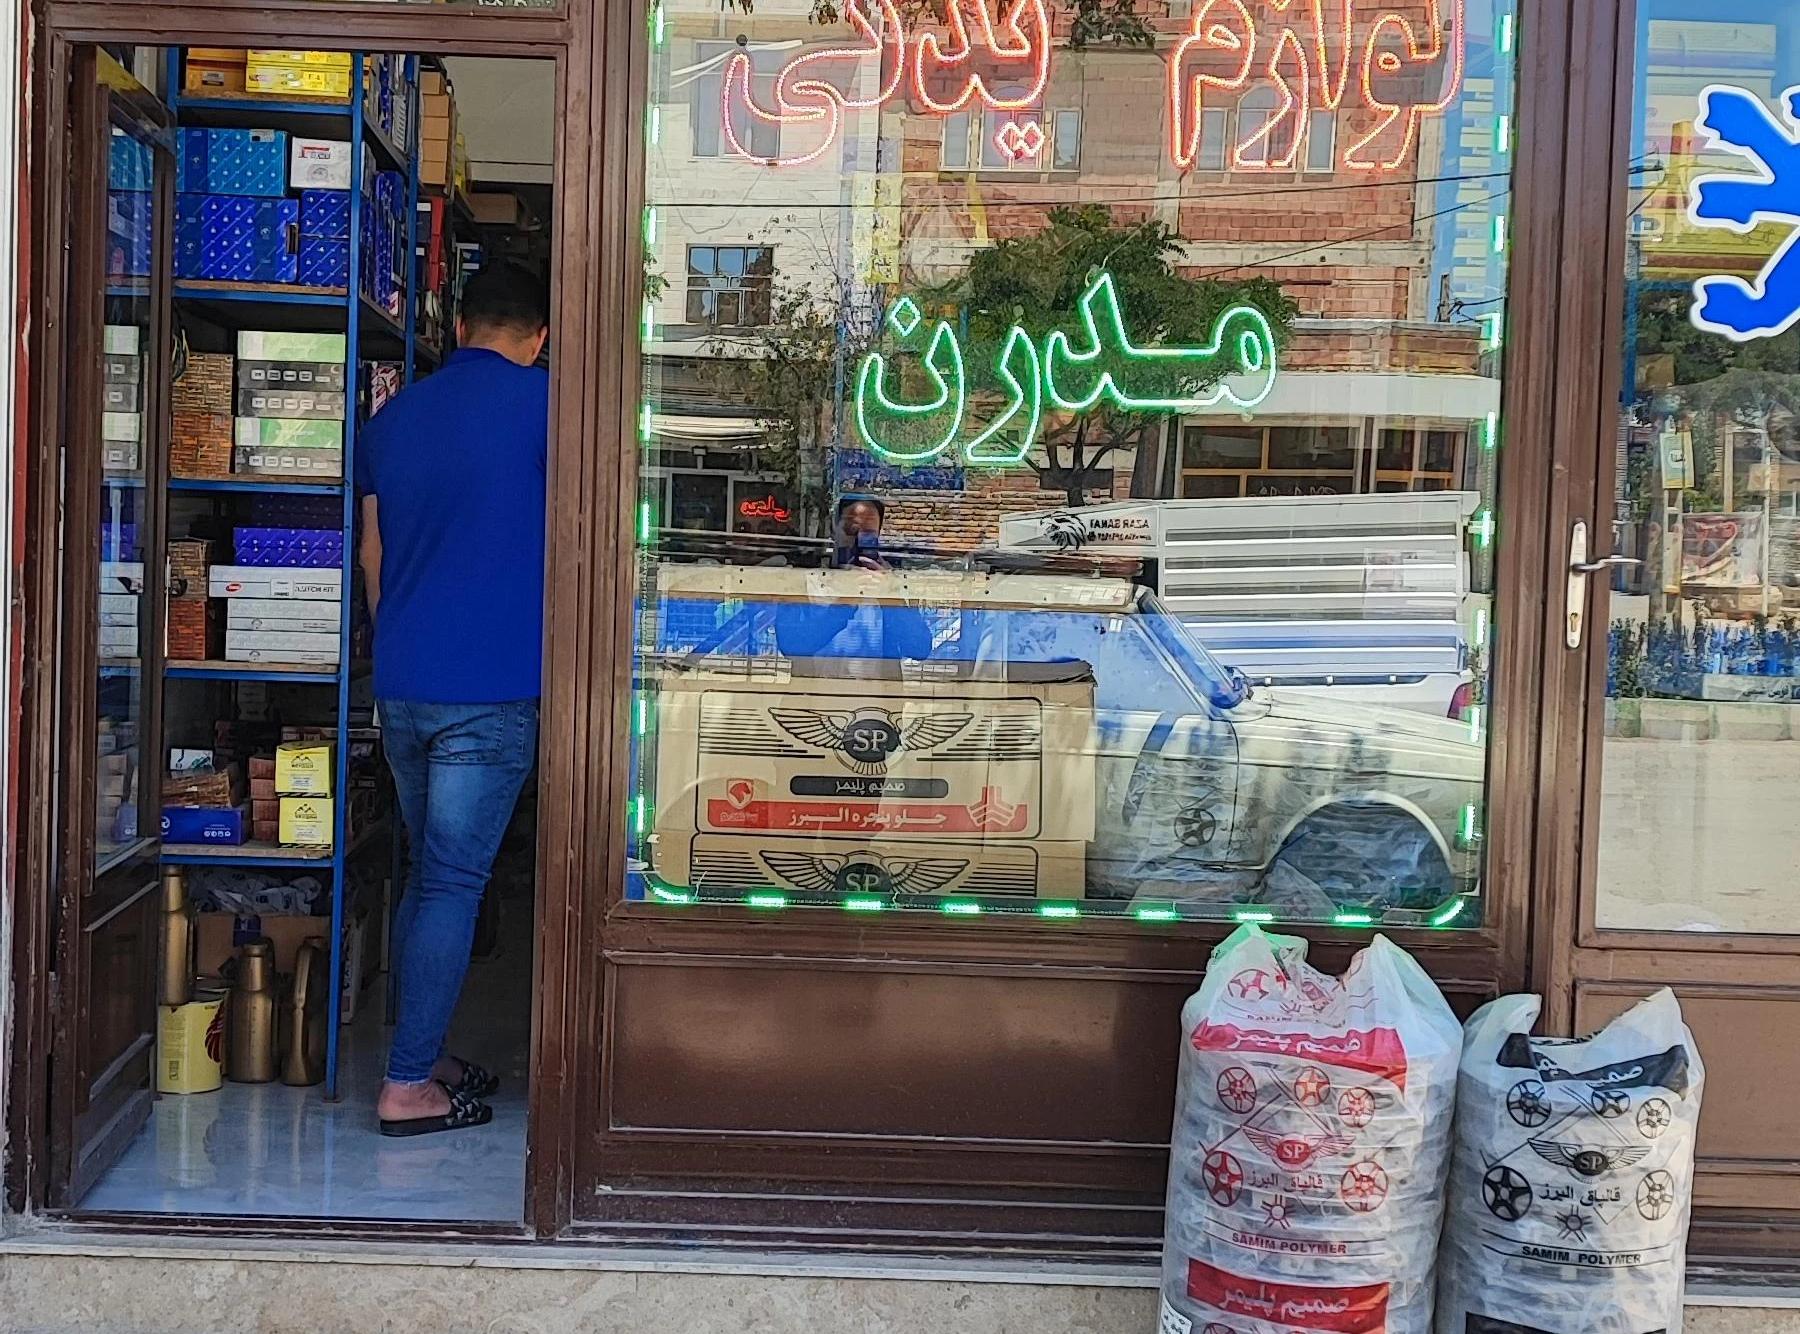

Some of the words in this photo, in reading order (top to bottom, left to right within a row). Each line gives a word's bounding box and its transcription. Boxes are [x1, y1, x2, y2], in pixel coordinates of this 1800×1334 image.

[855, 272, 1278, 463] مدرن
[852, 729, 888, 752] SP
[836, 778, 865, 795] پلیمر
[869, 780, 905, 793] صمیم
[788, 806, 849, 826] البرز
[845, 873, 880, 891] SP
[1283, 1145, 1305, 1159] SP
[1580, 1155, 1603, 1167] SP
[1538, 1184, 1574, 1202] البرز
[1232, 1232, 1276, 1250] SAMIM
[1280, 1241, 1348, 1254] POLYMER
[1522, 1246, 1570, 1262] SAMIM
[1578, 1253, 1641, 1265] POLYMER
[1218, 1284, 1277, 1317] پلیمر
[1280, 1297, 1350, 1321] صمیم
